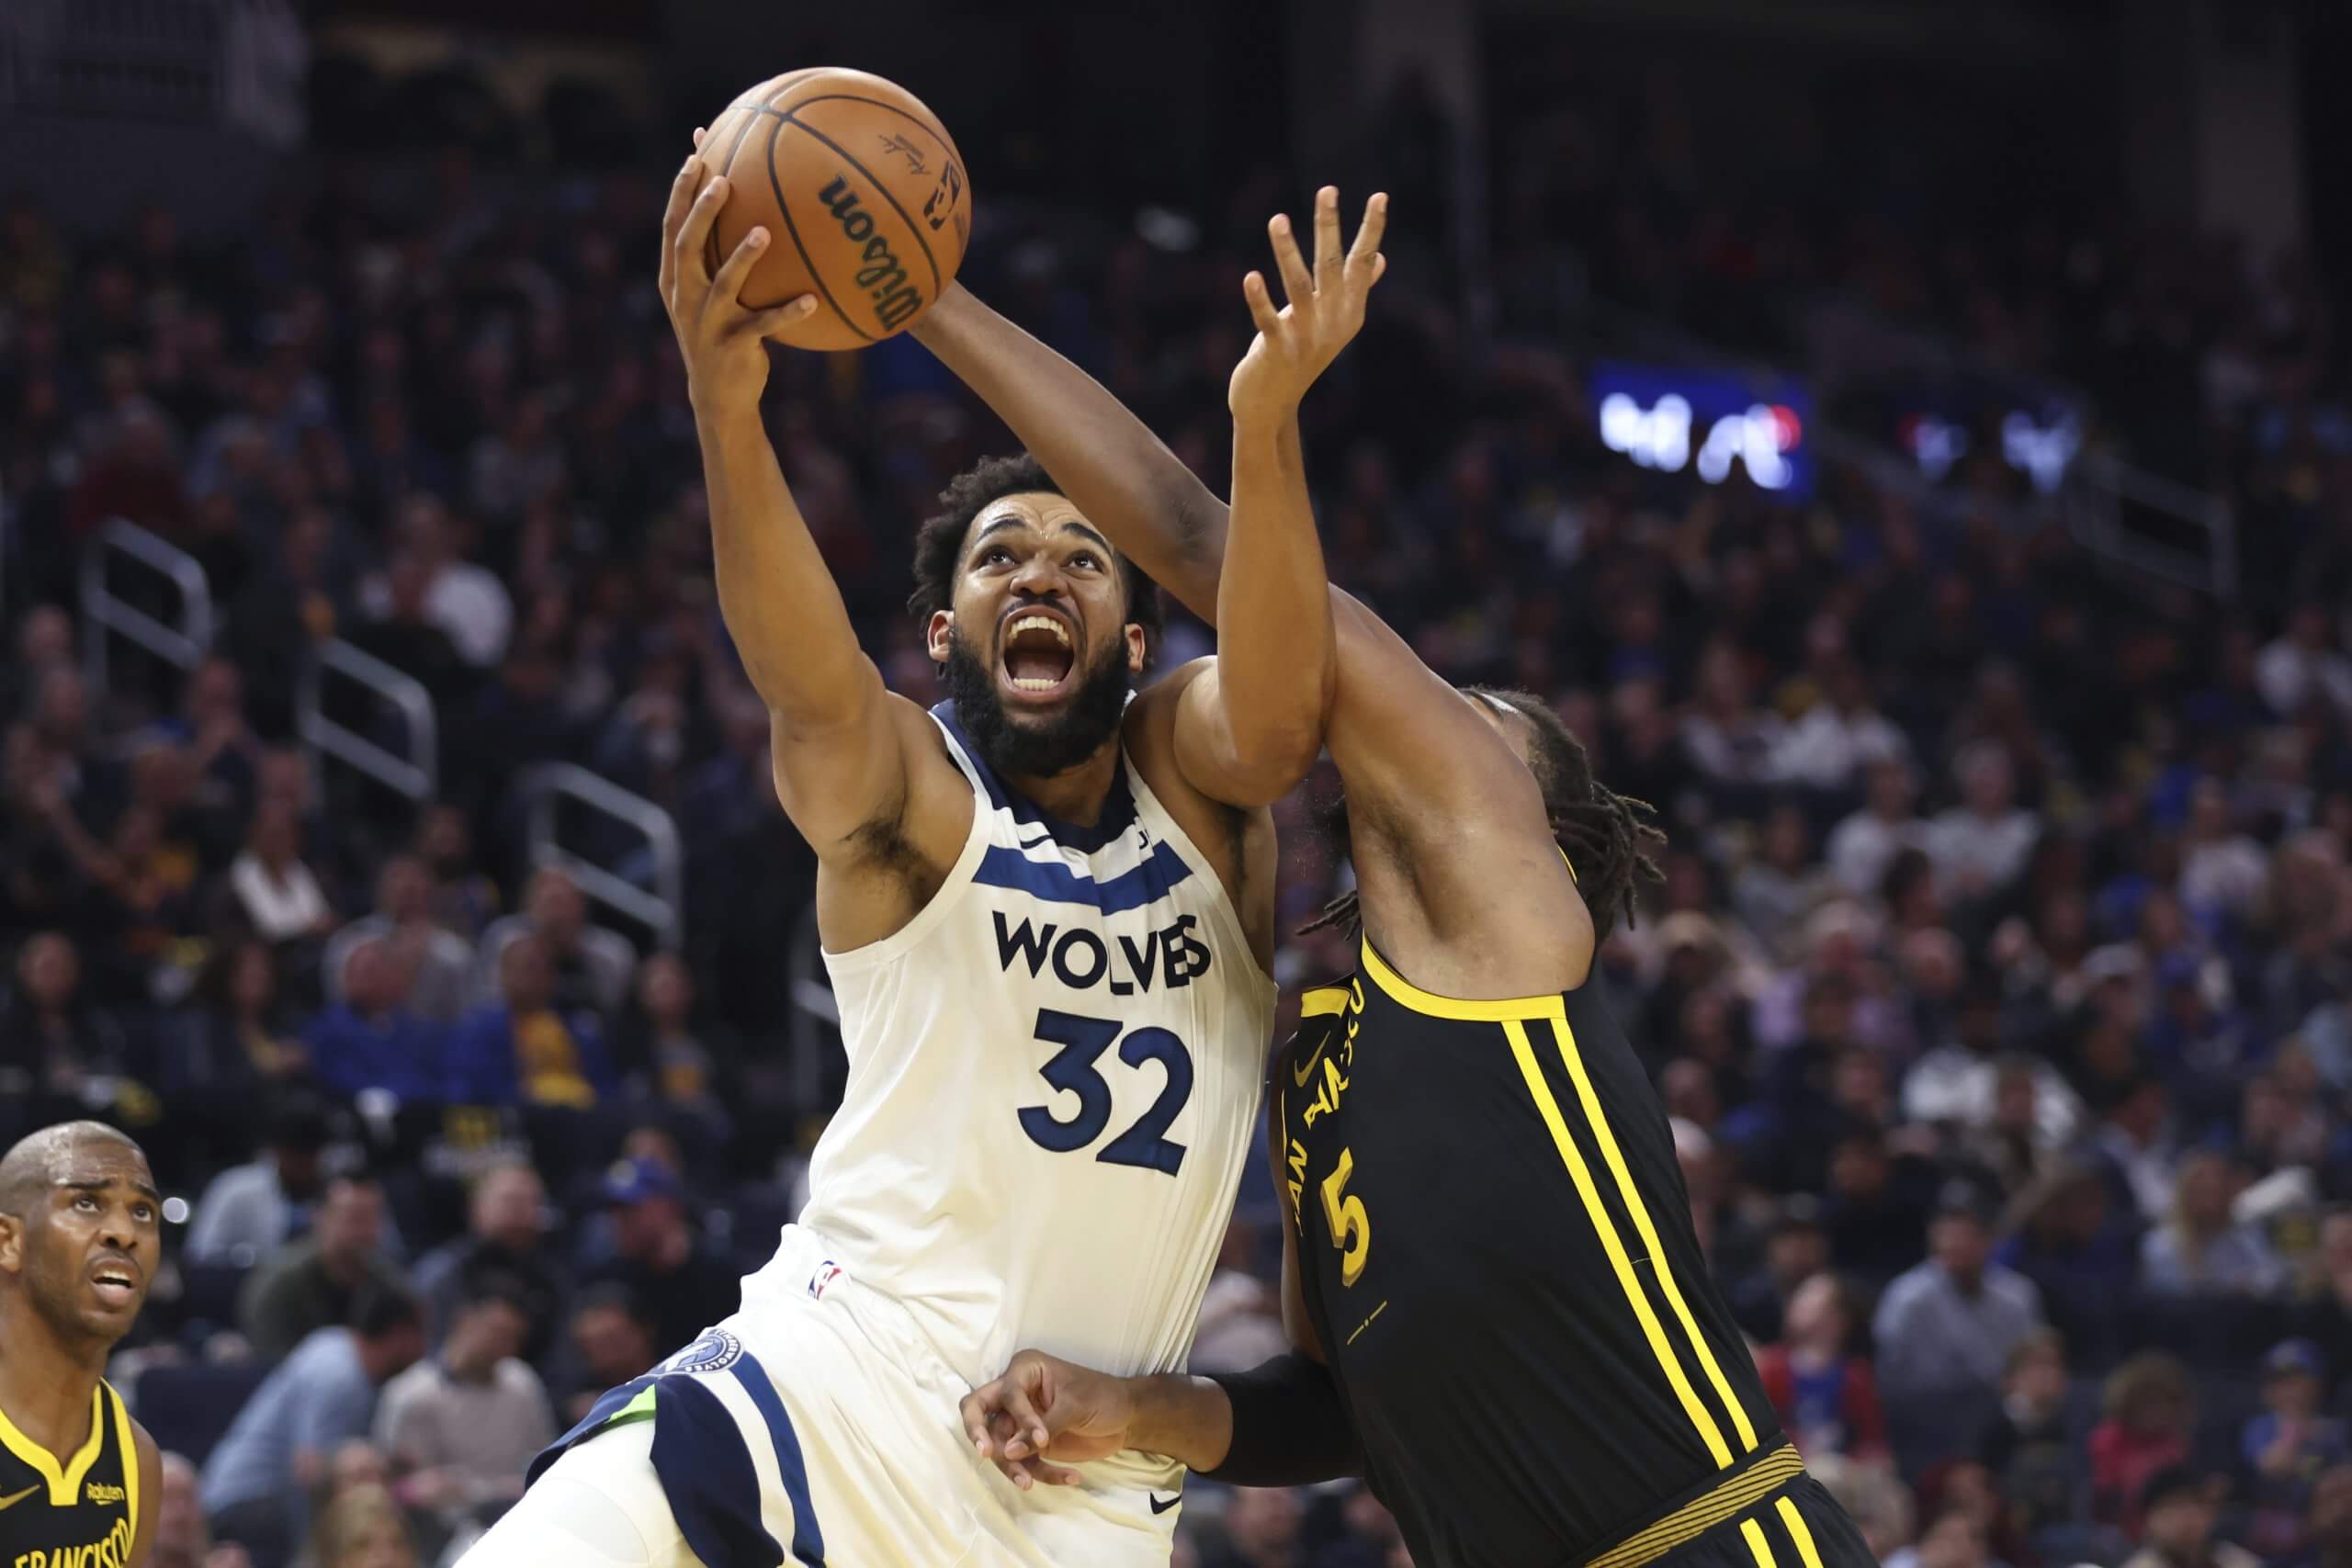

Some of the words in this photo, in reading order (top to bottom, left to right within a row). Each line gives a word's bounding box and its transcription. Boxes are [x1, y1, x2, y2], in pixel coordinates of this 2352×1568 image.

[819, 175, 922, 331] Wilson
[992, 910, 1211, 996] WOLVES
[1017, 1008, 1193, 1178] 32
[1286, 1138, 1308, 1236] AN
[1320, 1146, 1371, 1289] 5
